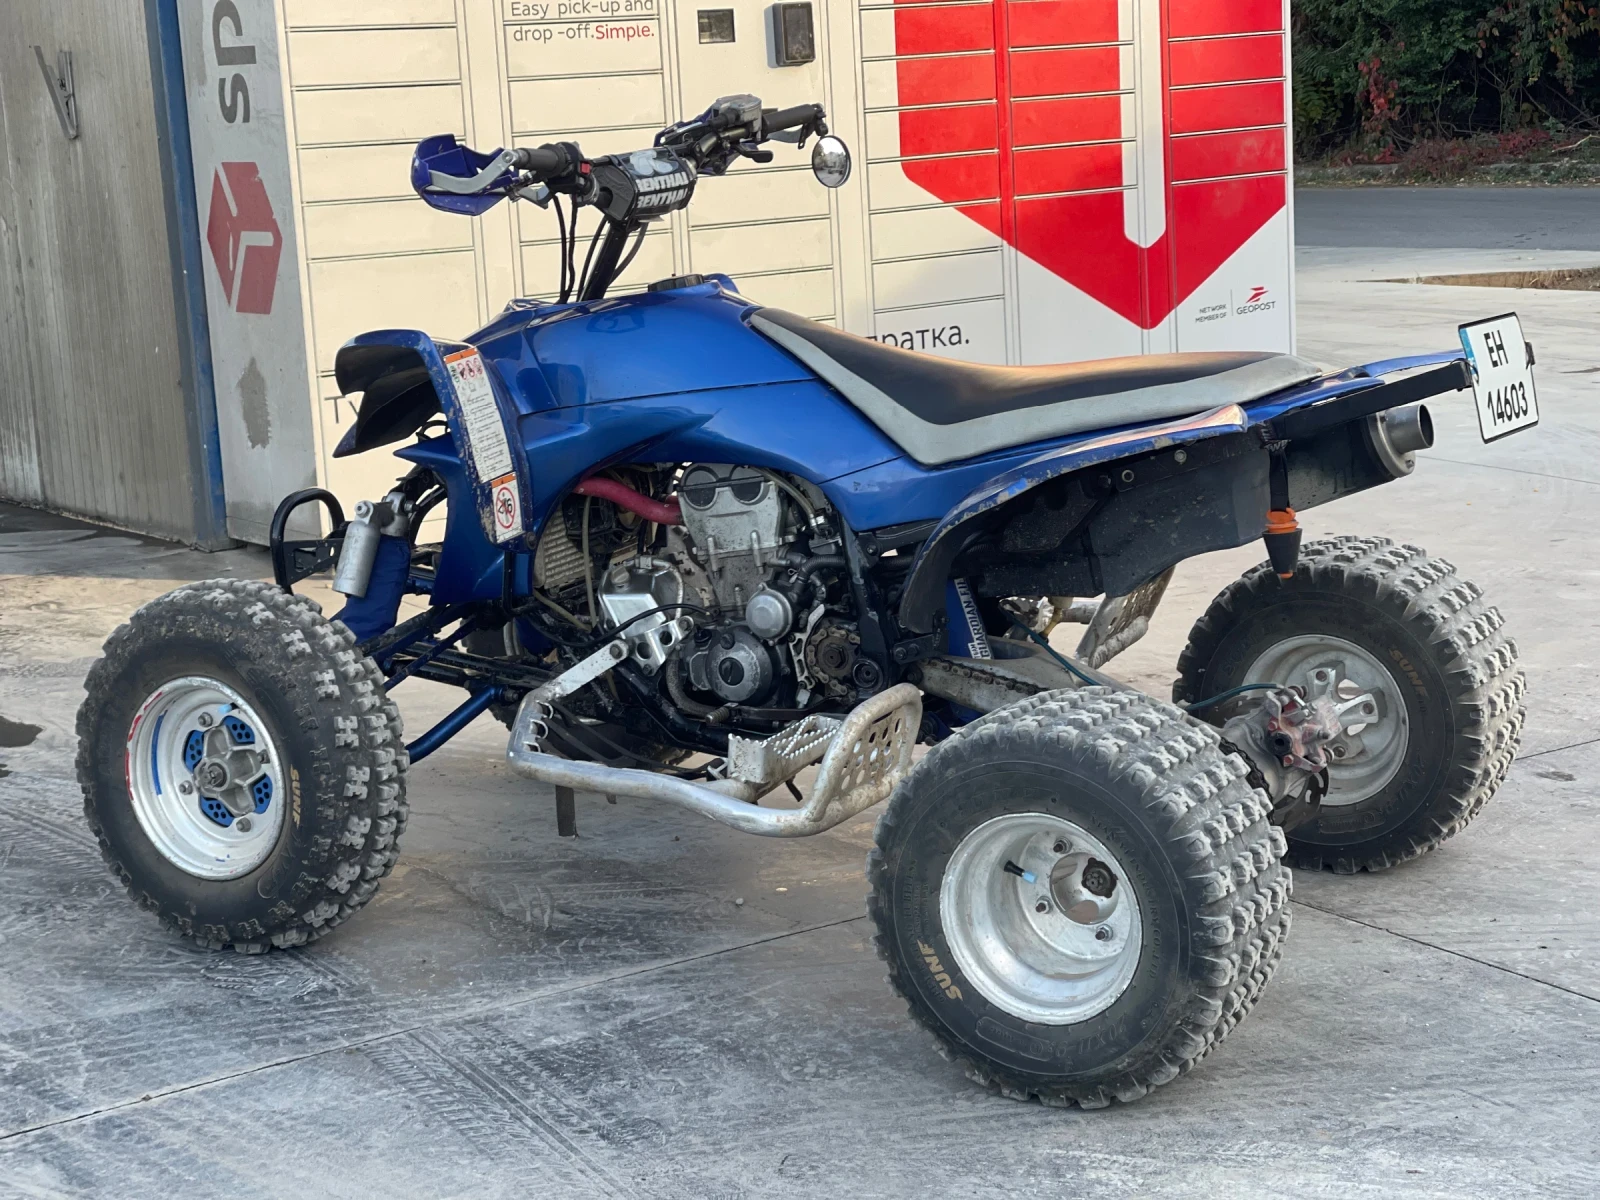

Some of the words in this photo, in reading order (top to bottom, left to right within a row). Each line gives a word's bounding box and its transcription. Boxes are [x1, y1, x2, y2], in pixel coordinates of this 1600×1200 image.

[511, 1, 549, 20] Easy
[558, 0, 620, 16] pick-up
[624, 0, 654, 12] and
[513, 25, 553, 44] drop
[1195, 313, 1219, 323] MEMBER
[1199, 303, 1227, 314] NETWORK
[1236, 301, 1276, 315] GEOPOST
[1487, 381, 1529, 427] 14603
[963, 600, 990, 658] GUARDIAN
[1388, 648, 1428, 698] SUNF
[290, 763, 303, 830] SUNF
[917, 939, 963, 1001] SUNF
